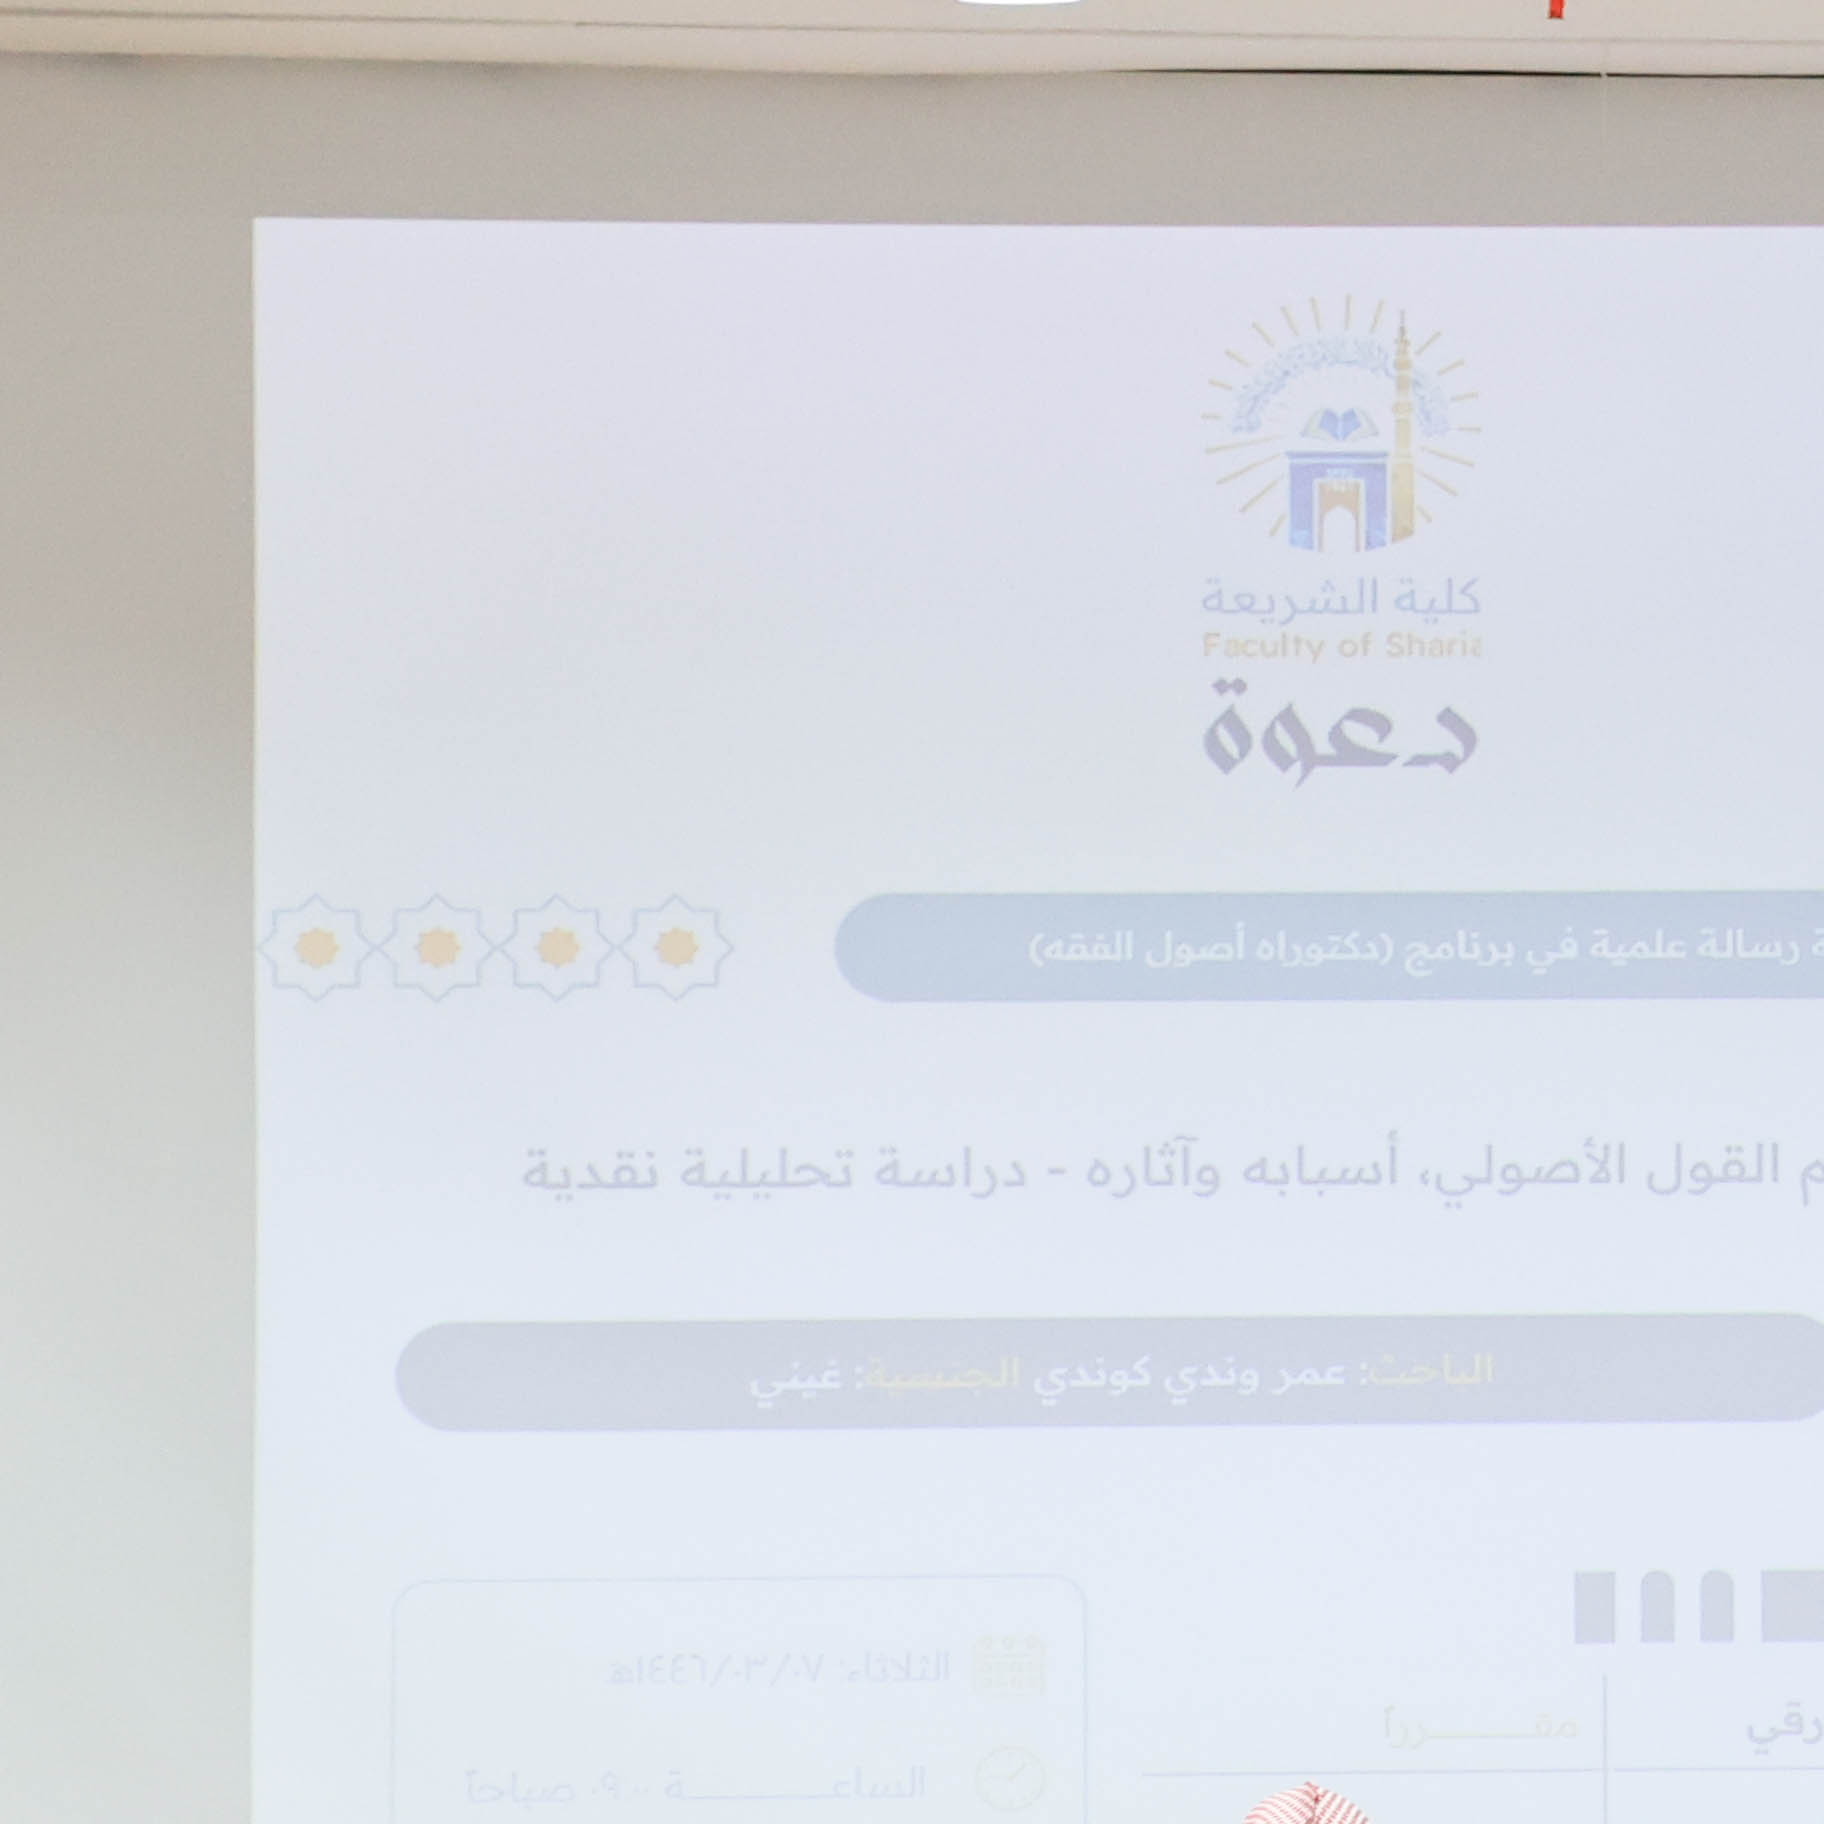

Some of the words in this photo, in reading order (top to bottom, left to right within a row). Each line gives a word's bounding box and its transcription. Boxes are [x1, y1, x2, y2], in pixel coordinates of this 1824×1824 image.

[1201, 576, 1379, 627] الشريعة
[1393, 576, 1482, 625] كلية
[1200, 627, 1327, 666] Faculty
[1335, 627, 1374, 660] of
[1202, 676, 1481, 789] دعوة
[1028, 929, 1135, 968] الفقه)
[1144, 920, 1246, 969] أصول
[1255, 929, 1395, 968] (دكتوراه
[1404, 928, 1516, 977] برنامج
[1525, 925, 1579, 975] في
[1589, 927, 1687, 966] علمية
[1696, 927, 1800, 966] رسالة
[522, 1148, 660, 1202] نقدية
[680, 1146, 855, 1201] تحليلية
[874, 1145, 1027, 1200] دراسة
[1086, 1134, 1223, 1199] وآثاره
[1242, 1129, 1400, 1197] أسبابه
[1419, 1136, 1626, 1210] الأصولي،
[1646, 1141, 1780, 1196] القول
[748, 1356, 845, 1404] غيني
[1032, 1352, 1153, 1406] كوندي
[1162, 1353, 1261, 1406] وندي
[1269, 1359, 1349, 1396] عمر
